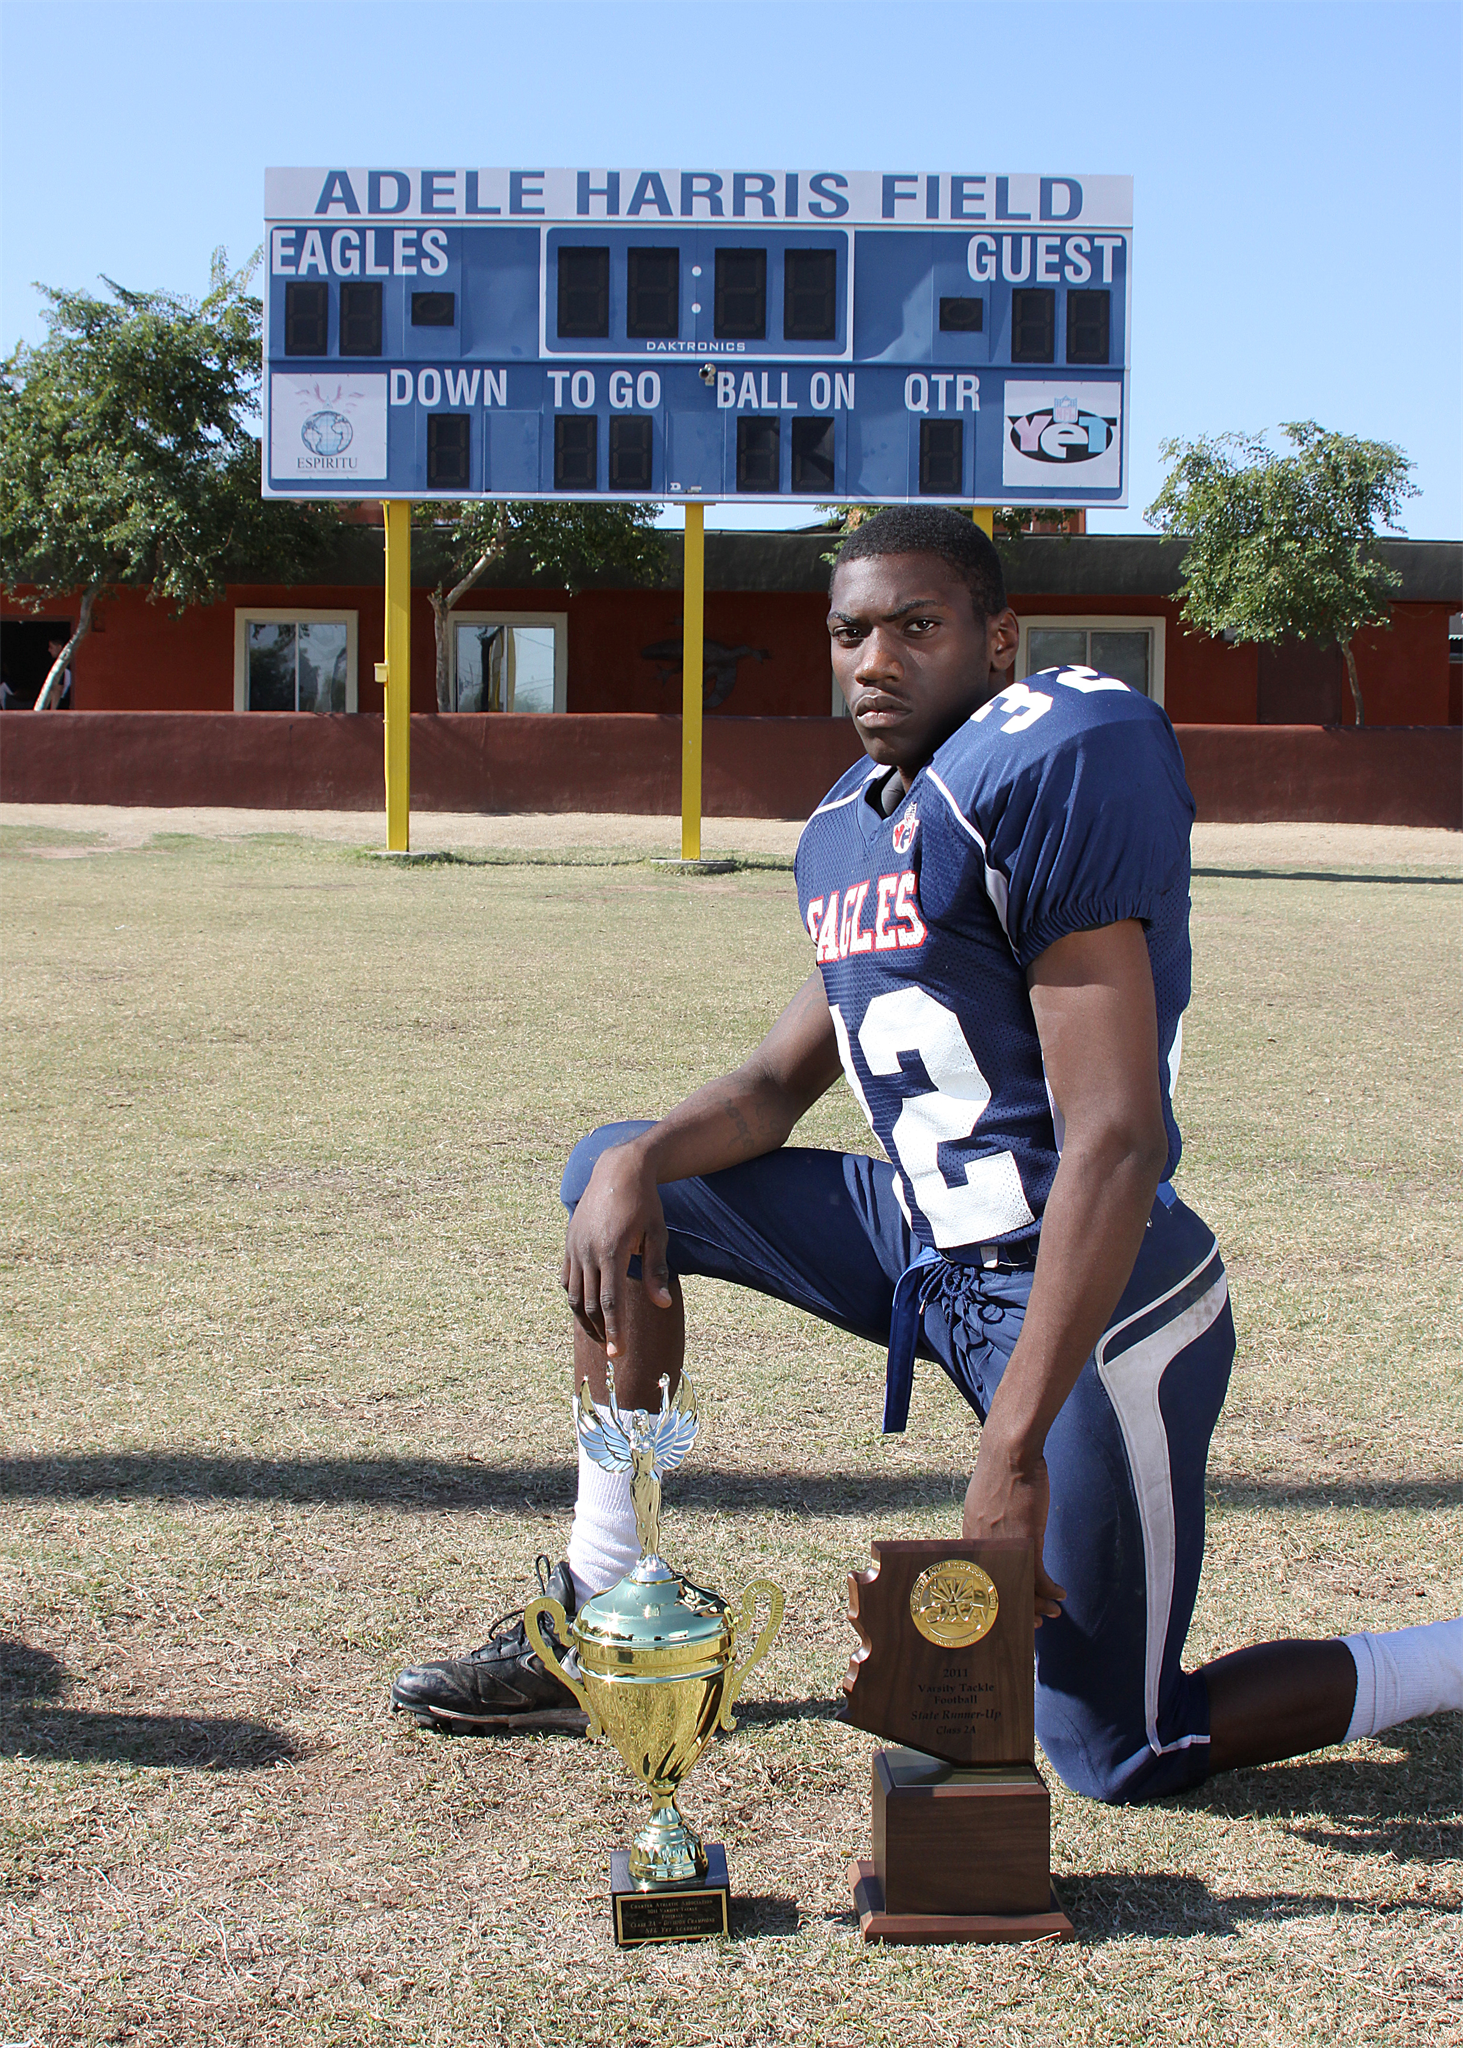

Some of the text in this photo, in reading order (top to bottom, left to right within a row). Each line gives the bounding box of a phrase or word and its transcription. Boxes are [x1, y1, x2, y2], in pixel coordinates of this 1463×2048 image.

[314, 170, 1084, 221] ADELE HARRIS FIELD
[271, 228, 449, 276] EAGLES
[967, 234, 1122, 283] GUEST
[646, 341, 746, 352] DAKTRONICS
[390, 368, 507, 406] DOWN
[547, 370, 661, 408] TO GO
[717, 371, 855, 410] BALL ON
[905, 372, 981, 413] QTR
[297, 457, 358, 469] ESPIRITU
[806, 870, 928, 964] EAGLES
[918, 1683, 995, 1694] Varsity Tackle
[943, 1668, 968, 1678] 2011
[911, 1709, 1001, 1721] State Runner-Up
[934, 1695, 977, 1704] Football
[936, 1725, 976, 1735] Class 2A
